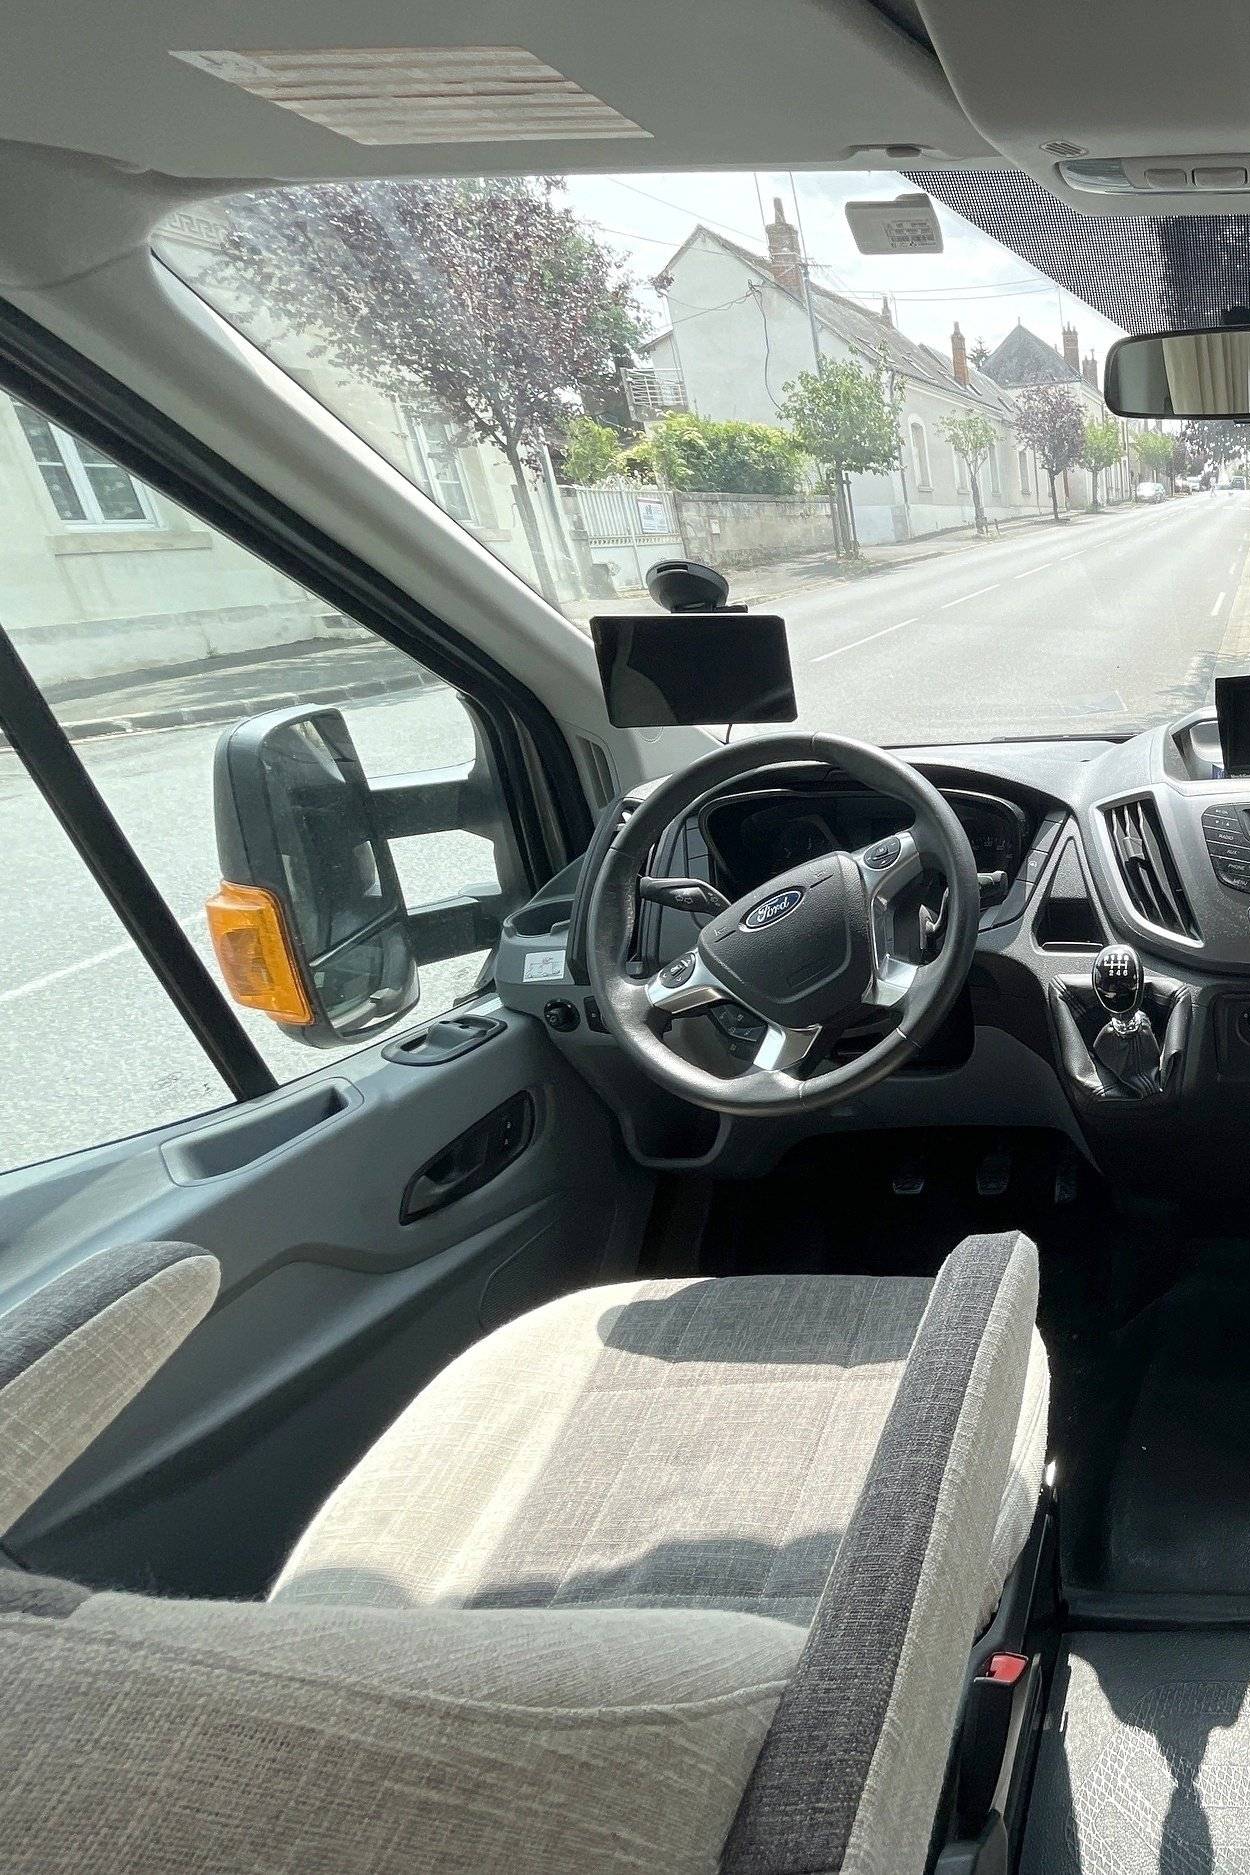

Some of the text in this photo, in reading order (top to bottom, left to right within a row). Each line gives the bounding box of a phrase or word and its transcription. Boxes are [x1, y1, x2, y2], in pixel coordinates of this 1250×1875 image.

[1218, 833, 1234, 841] RADIO
[756, 896, 790, 923] Ford
[1108, 969, 1128, 977] 2 4 6
